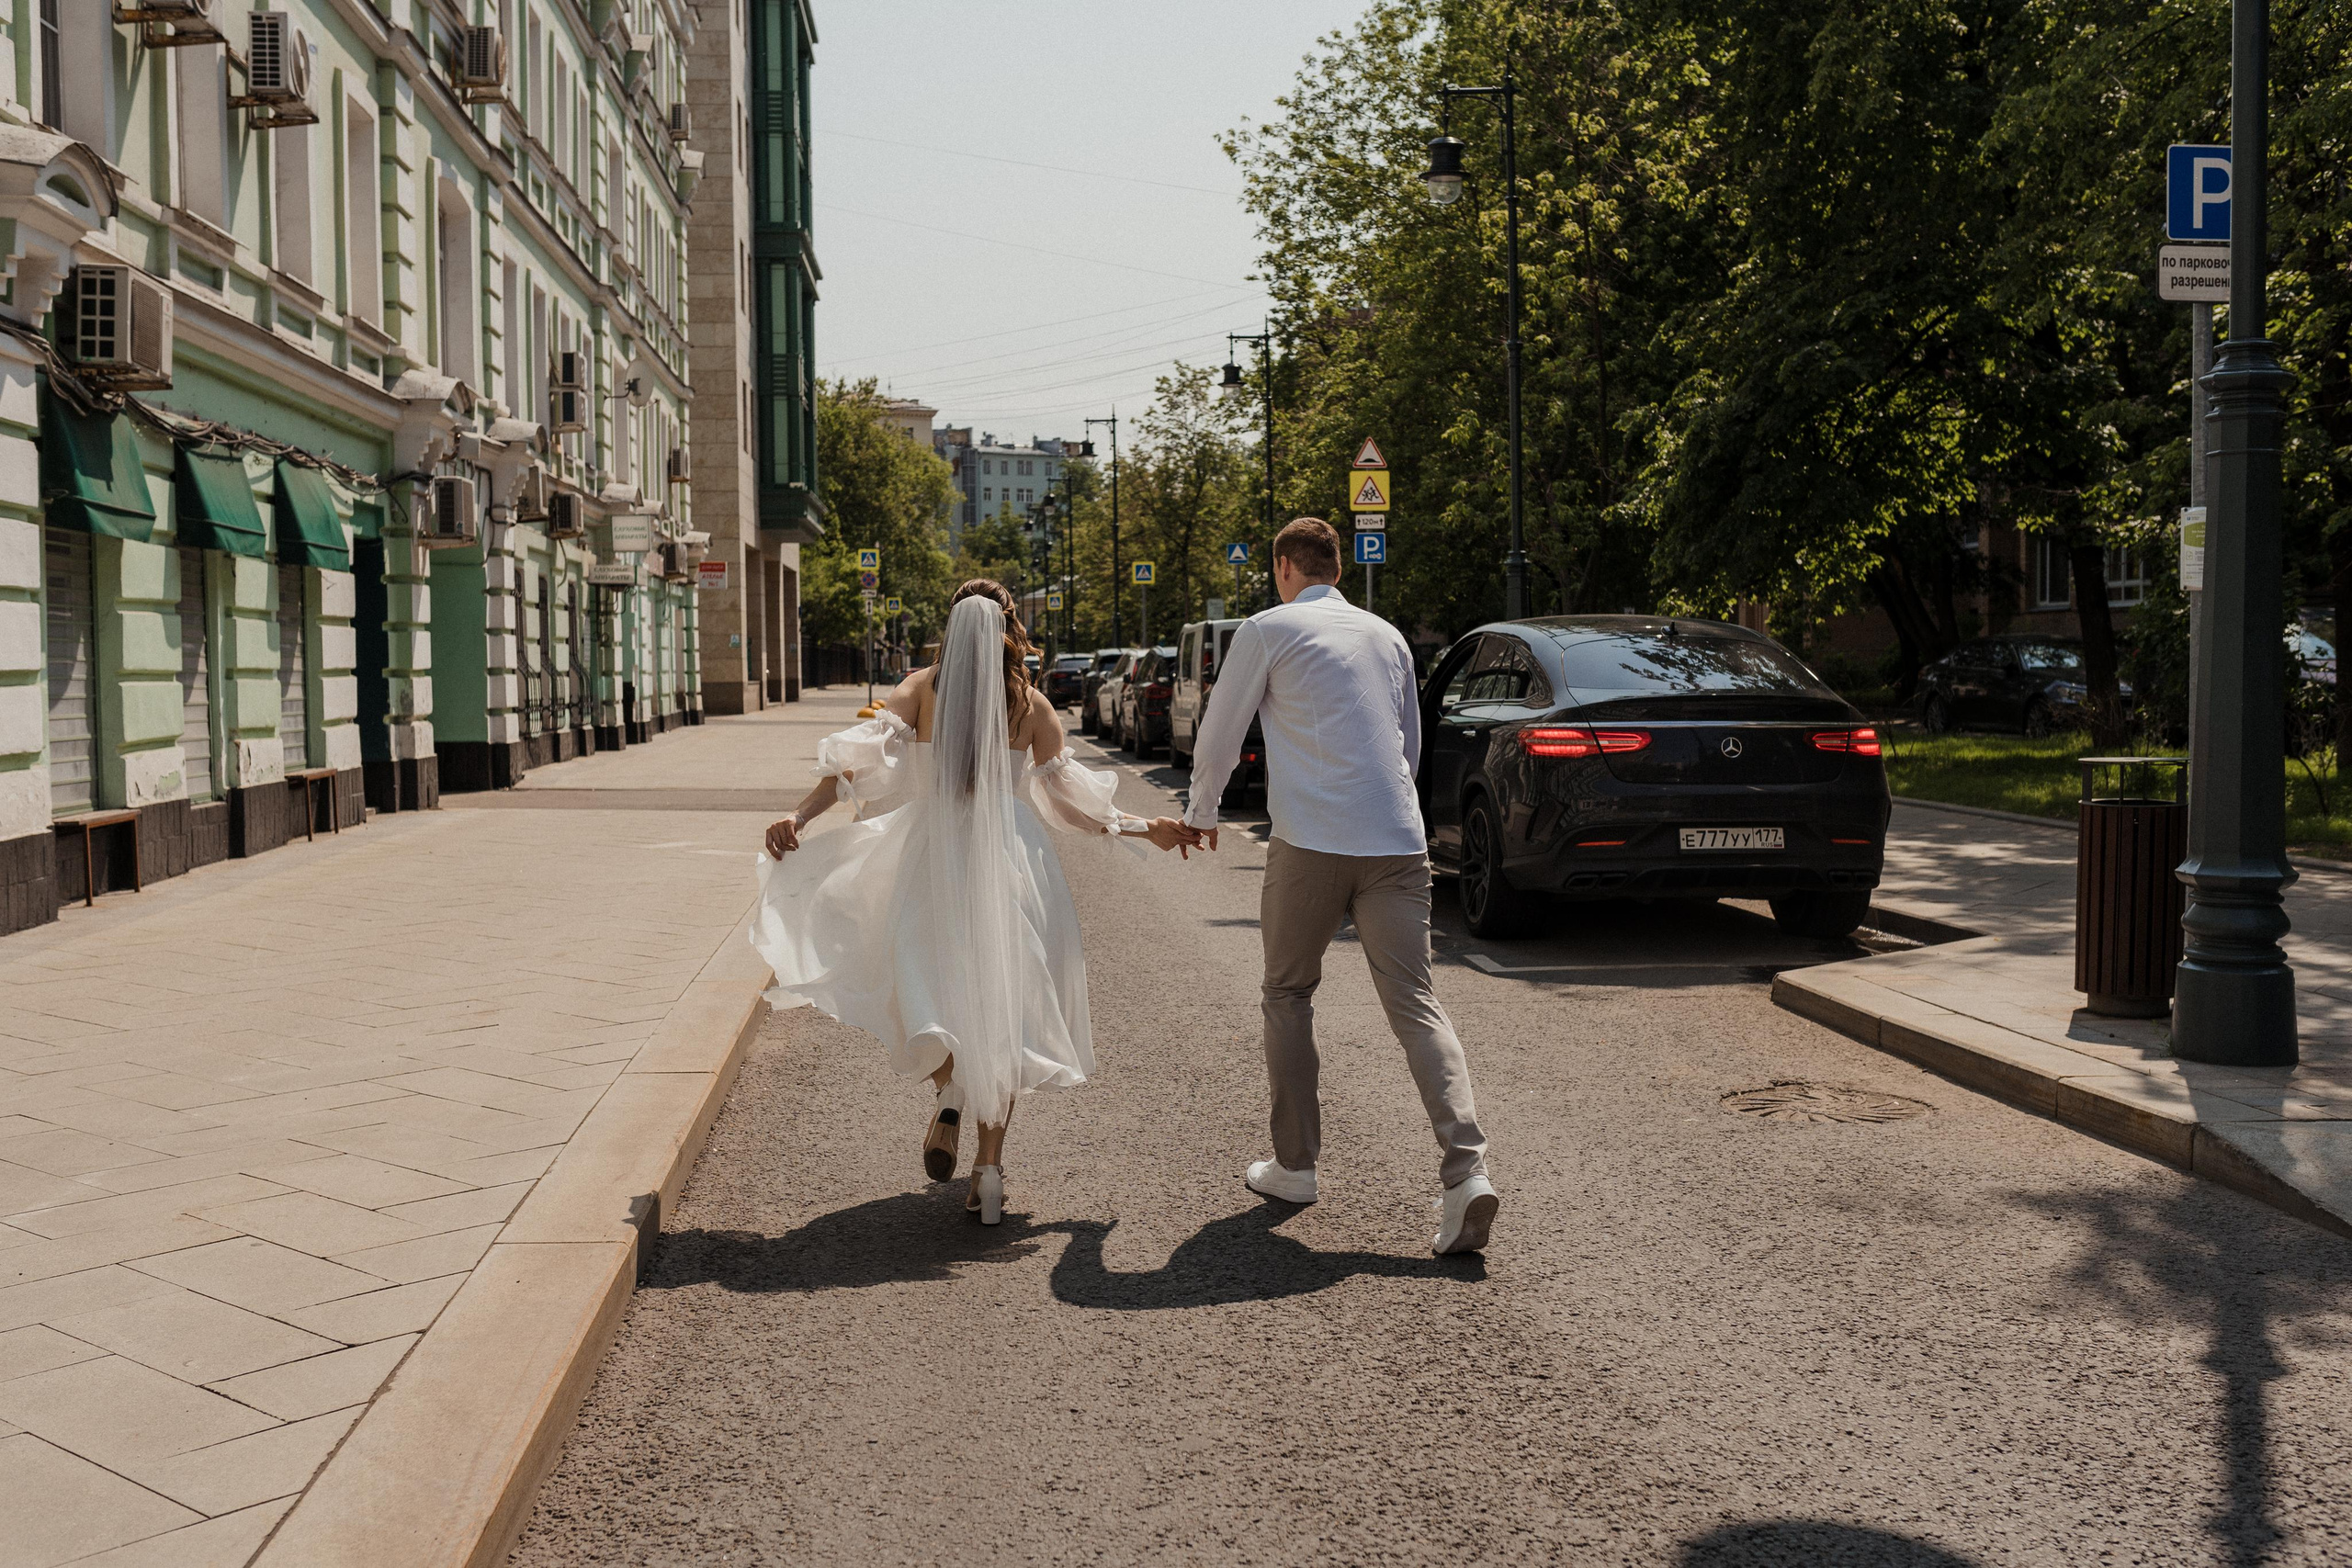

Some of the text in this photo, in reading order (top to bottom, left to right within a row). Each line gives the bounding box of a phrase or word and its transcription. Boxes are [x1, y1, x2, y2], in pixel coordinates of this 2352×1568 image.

[2193, 157, 2233, 229] P
[2162, 256, 2177, 267] по
[2171, 276, 2230, 290] разрешен
[1363, 536, 1380, 559] P
[1756, 829, 1779, 842] 177
